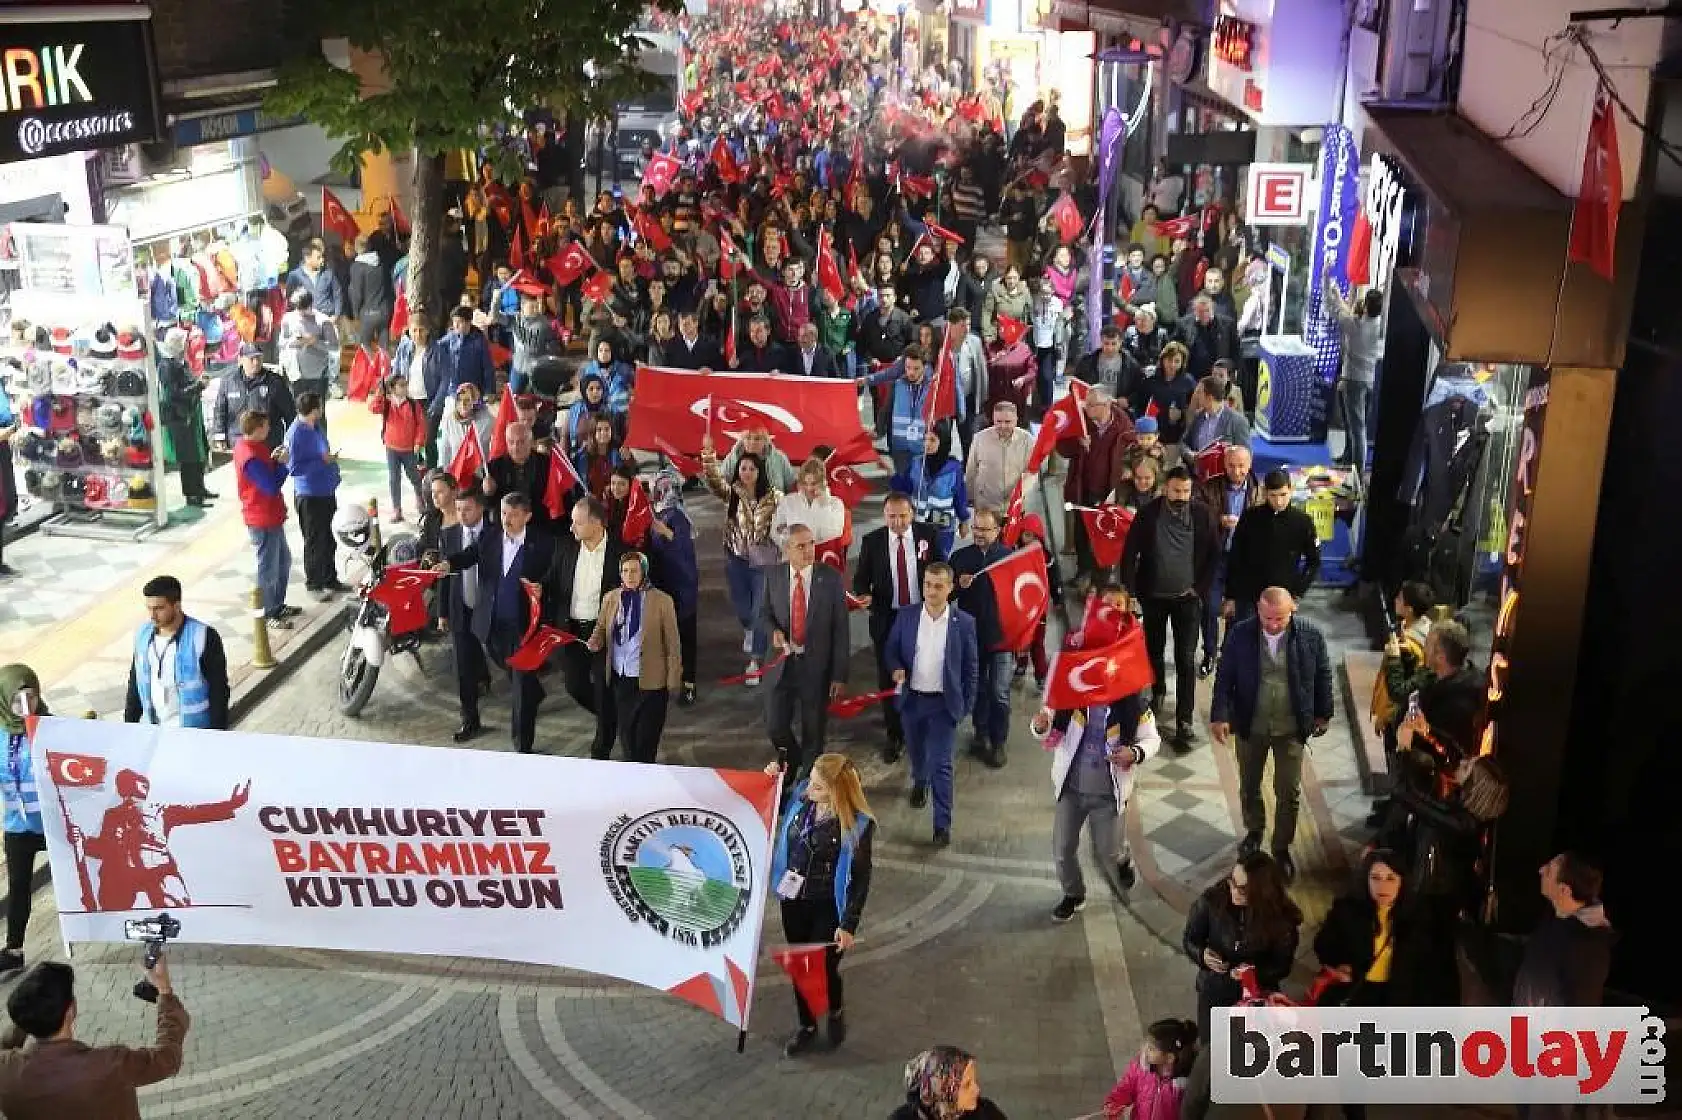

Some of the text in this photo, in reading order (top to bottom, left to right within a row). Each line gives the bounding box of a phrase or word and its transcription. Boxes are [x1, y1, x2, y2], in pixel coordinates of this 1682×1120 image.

[0, 44, 93, 112] RIK
[1264, 179, 1293, 211] E
[273, 839, 558, 876] BAYRAMIMIZ
[285, 877, 564, 910] KUTLU OLSUN
